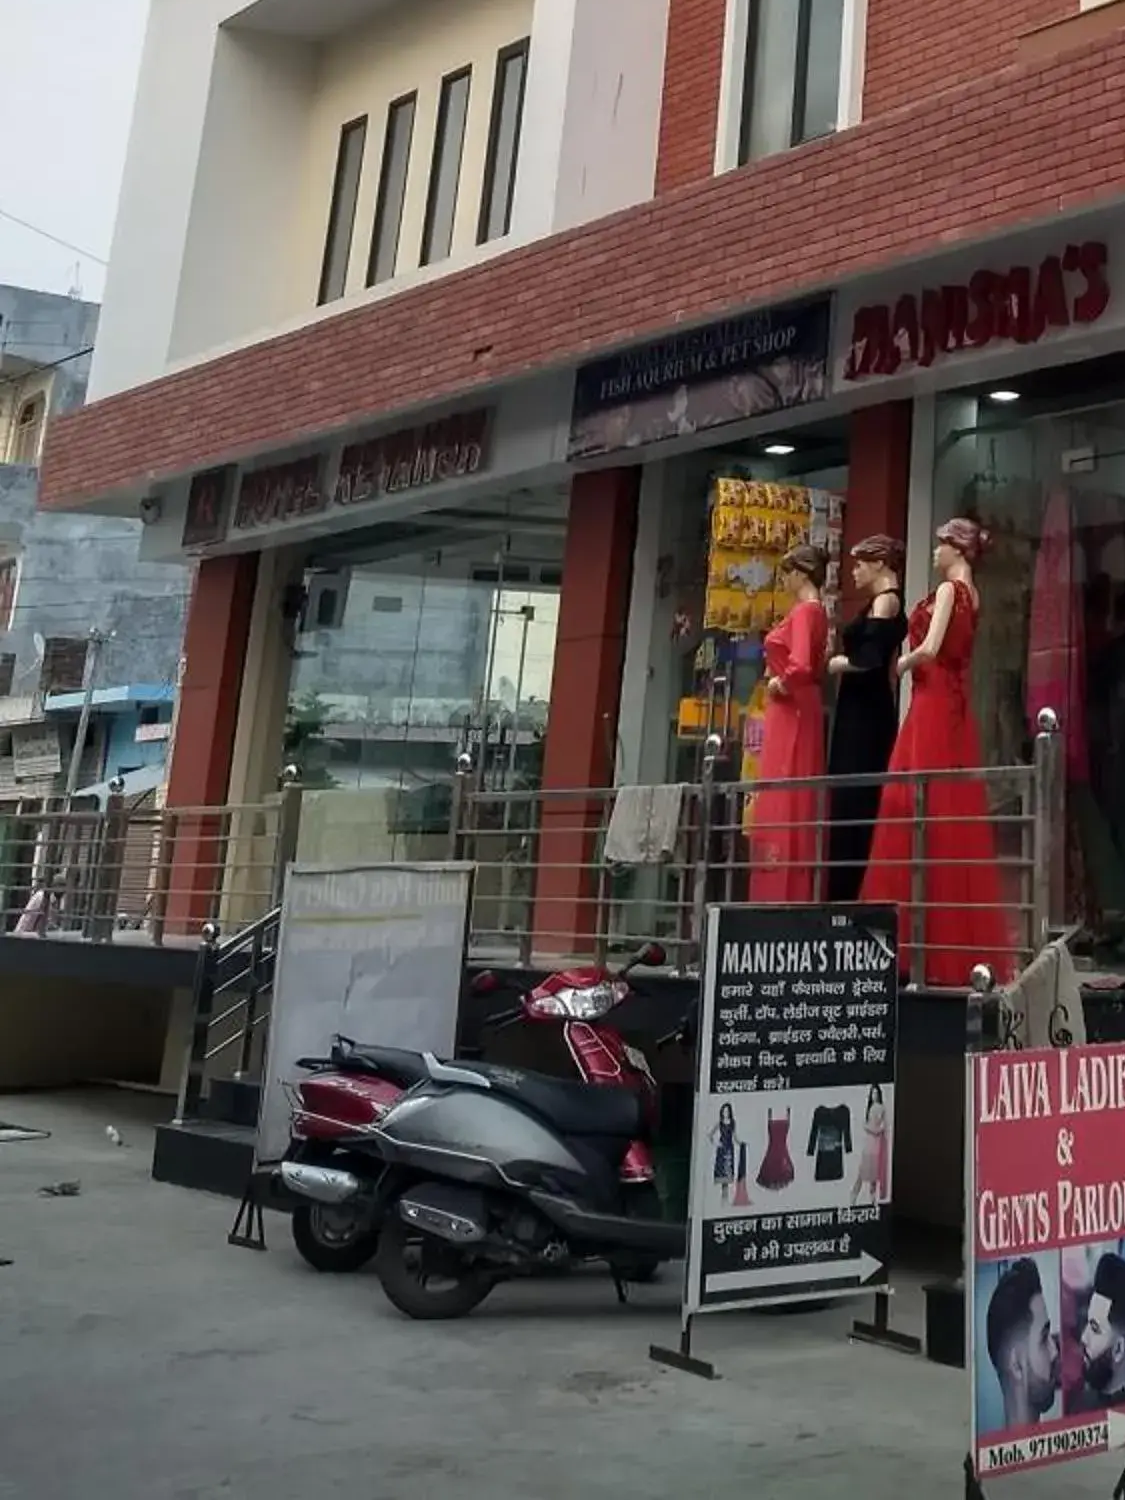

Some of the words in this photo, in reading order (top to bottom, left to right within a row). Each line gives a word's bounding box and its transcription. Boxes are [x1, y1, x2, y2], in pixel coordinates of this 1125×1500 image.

[753, 326, 797, 355] SHOP
[721, 941, 828, 974] MANISHA'S
[719, 981, 755, 1000] हमारे
[783, 1001, 821, 1021] लेडीज
[822, 1005, 842, 1023] सूट
[843, 1048, 857, 1063] के
[979, 1056, 1052, 1124] LAIVA
[1057, 1127, 1075, 1167] &
[713, 1219, 758, 1243] दुल्हन
[761, 1217, 785, 1234] का
[786, 1211, 833, 1230] सामान
[979, 1190, 1051, 1251] GENTS
[762, 1238, 780, 1260] भी
[783, 1239, 837, 1257] उपलब्ध
[1029, 1423, 1109, 1461] 9719020374
